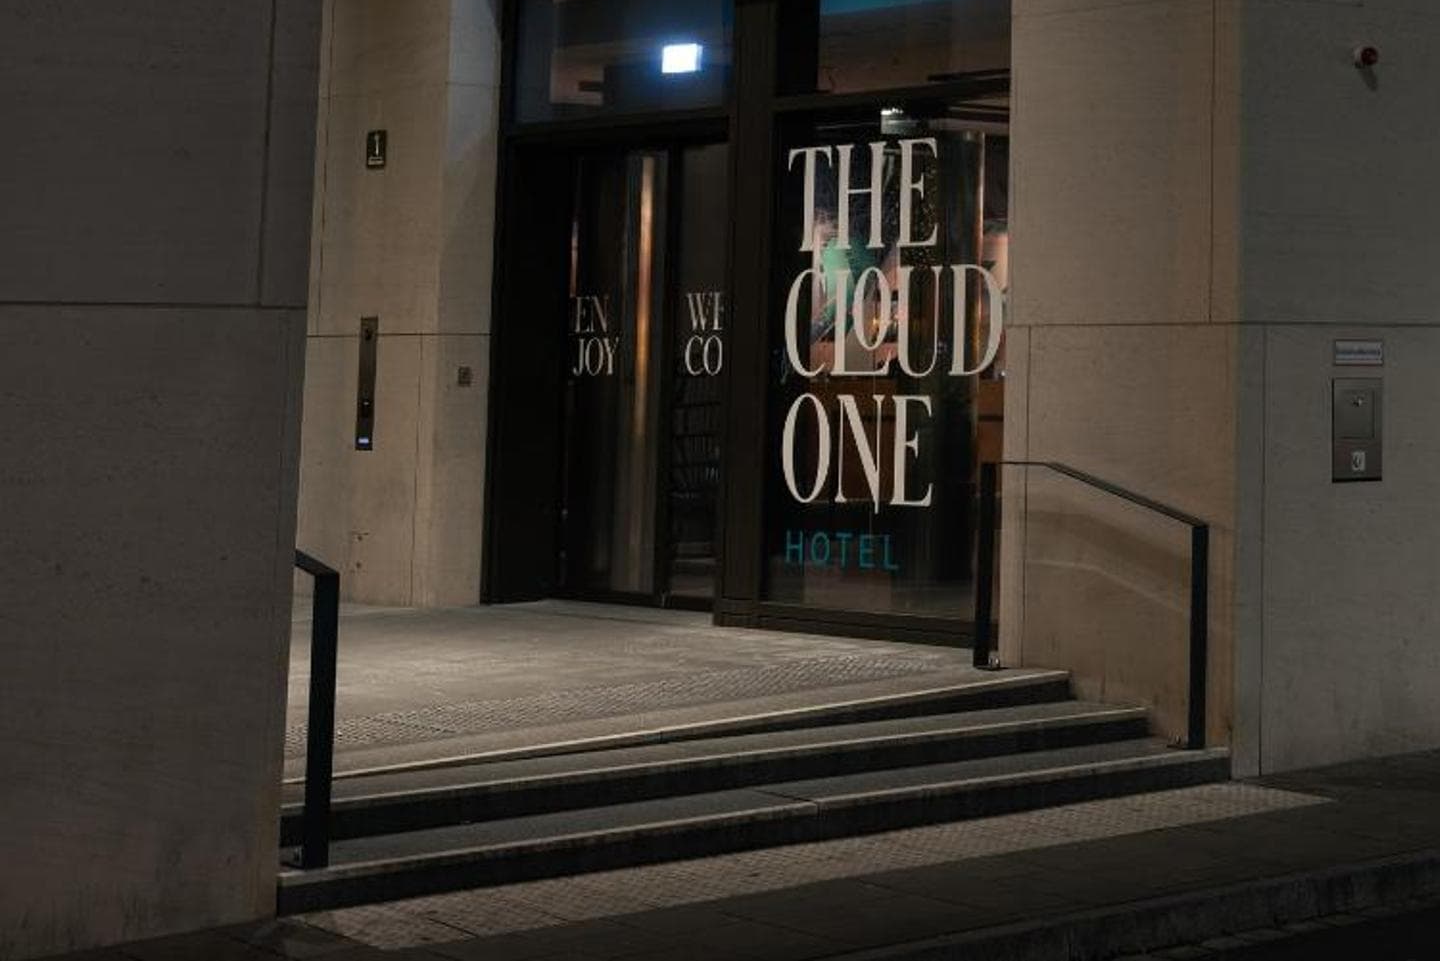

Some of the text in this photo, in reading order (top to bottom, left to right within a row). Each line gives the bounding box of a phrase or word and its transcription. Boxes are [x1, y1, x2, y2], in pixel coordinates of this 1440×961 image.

[787, 137, 939, 253] THE
[575, 294, 609, 333] EN
[784, 264, 1004, 379] CLOUD
[572, 336, 620, 377] JOY
[685, 335, 723, 376] CO
[781, 392, 934, 515] ONE
[785, 529, 900, 571] HOTEL
